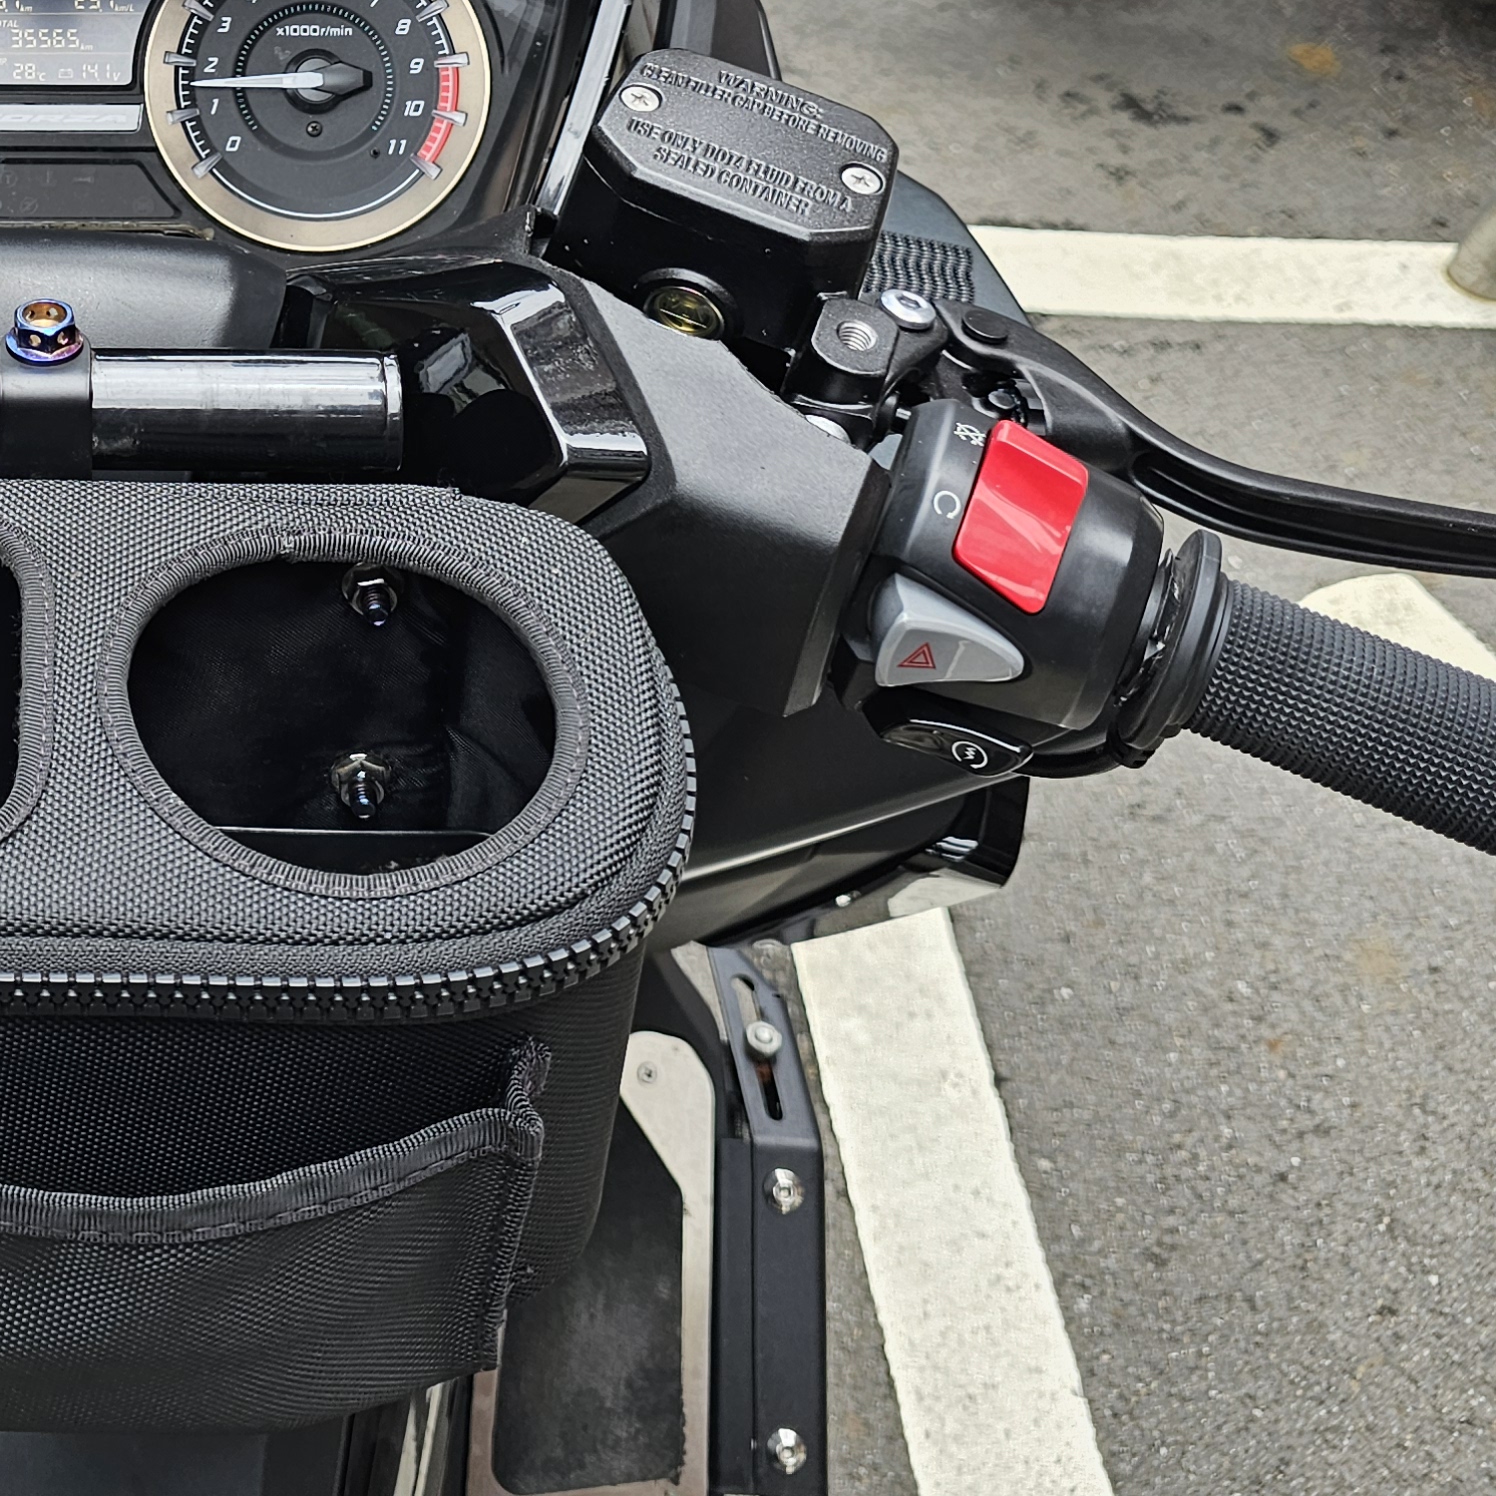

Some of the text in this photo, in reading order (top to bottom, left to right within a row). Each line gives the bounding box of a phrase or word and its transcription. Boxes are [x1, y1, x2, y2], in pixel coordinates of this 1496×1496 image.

[217, 17, 232, 33] 3
[395, 19, 411, 35] 8
[204, 57, 219, 73] 2
[409, 58, 425, 74] 9
[210, 98, 219, 115] 1
[404, 100, 425, 117] 10
[640, 62, 888, 162] CLEAN FILLER CAP BEFORE REMOVING
[225, 136, 241, 152] 0
[388, 139, 407, 155] 11
[626, 116, 663, 140] USE
[661, 128, 706, 153] ONLY
[746, 157, 794, 189] FLUID
[793, 175, 842, 207] FROM
[653, 145, 812, 216] SEALED CONTAINER
